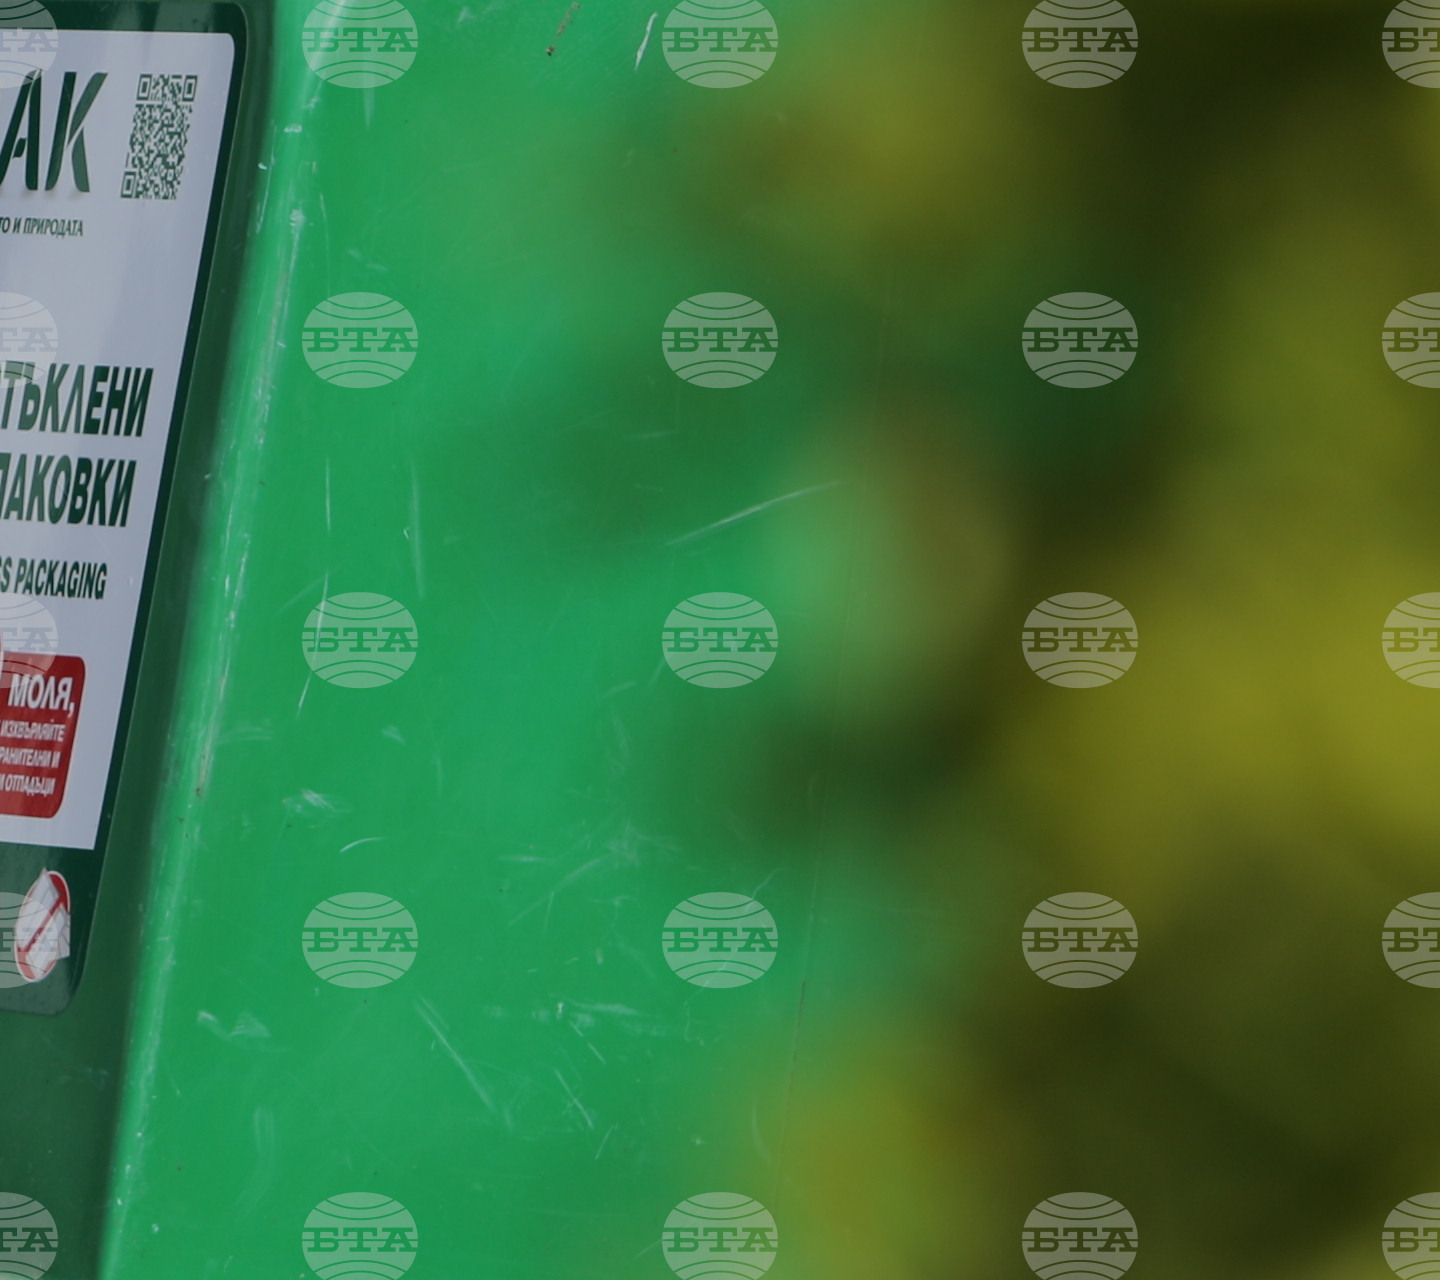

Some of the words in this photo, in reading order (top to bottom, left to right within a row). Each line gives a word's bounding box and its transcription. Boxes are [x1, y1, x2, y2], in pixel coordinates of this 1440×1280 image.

[13, 217, 21, 233] И
[23, 217, 83, 237] ПРИРОДАТА
[14, 558, 108, 600] PACKAGING
[8, 673, 75, 719] МОЛЯ,
[51, 751, 61, 768] И
[5, 774, 56, 796] ОТПАДЪЦИ
